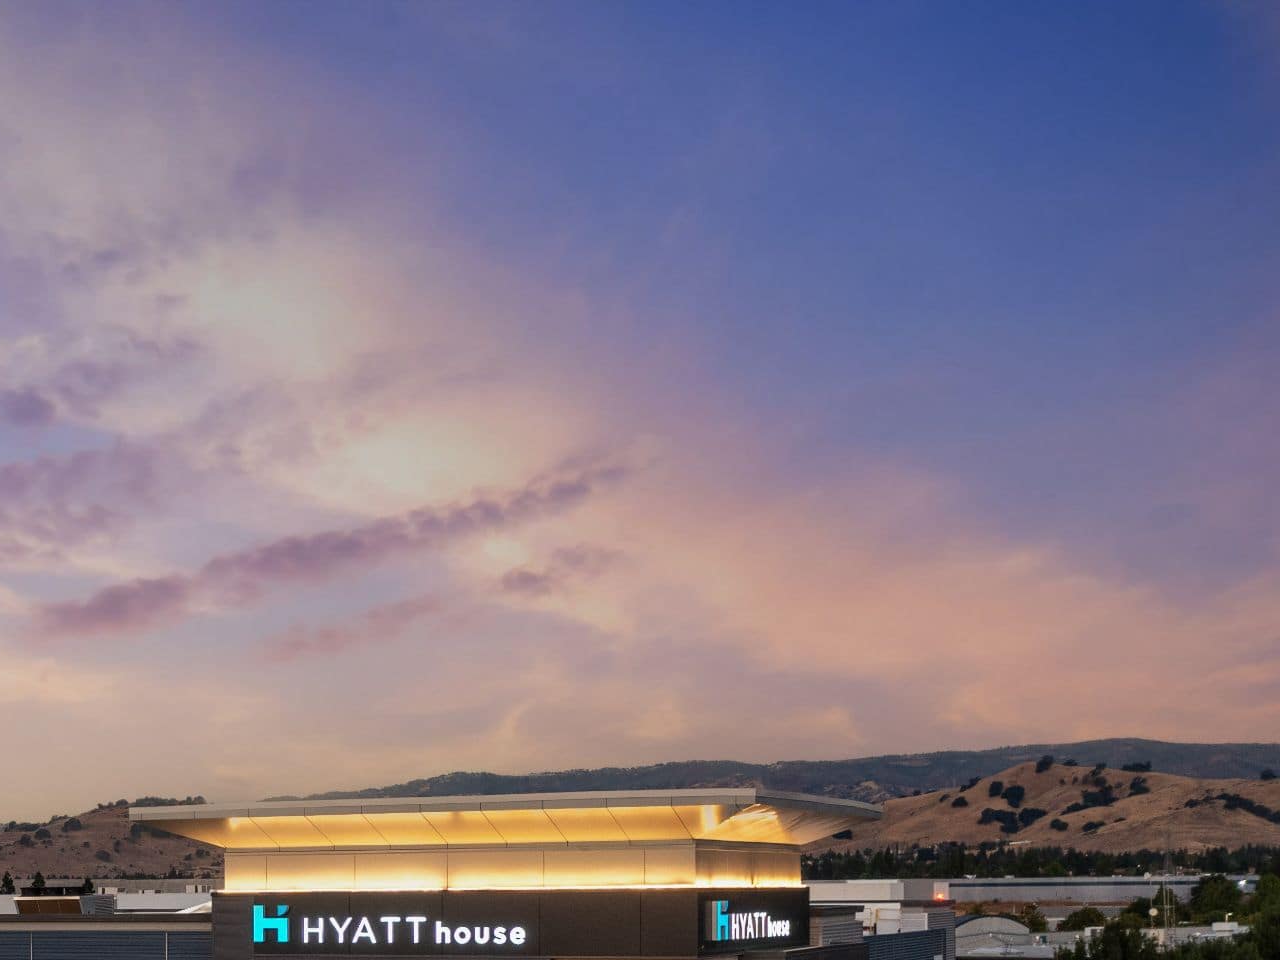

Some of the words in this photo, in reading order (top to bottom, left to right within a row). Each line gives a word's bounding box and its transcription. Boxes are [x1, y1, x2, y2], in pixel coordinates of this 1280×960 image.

[302, 916, 428, 945] HYATT
[435, 920, 527, 945] house
[731, 912, 767, 940] HYATT
[767, 915, 790, 937] house
